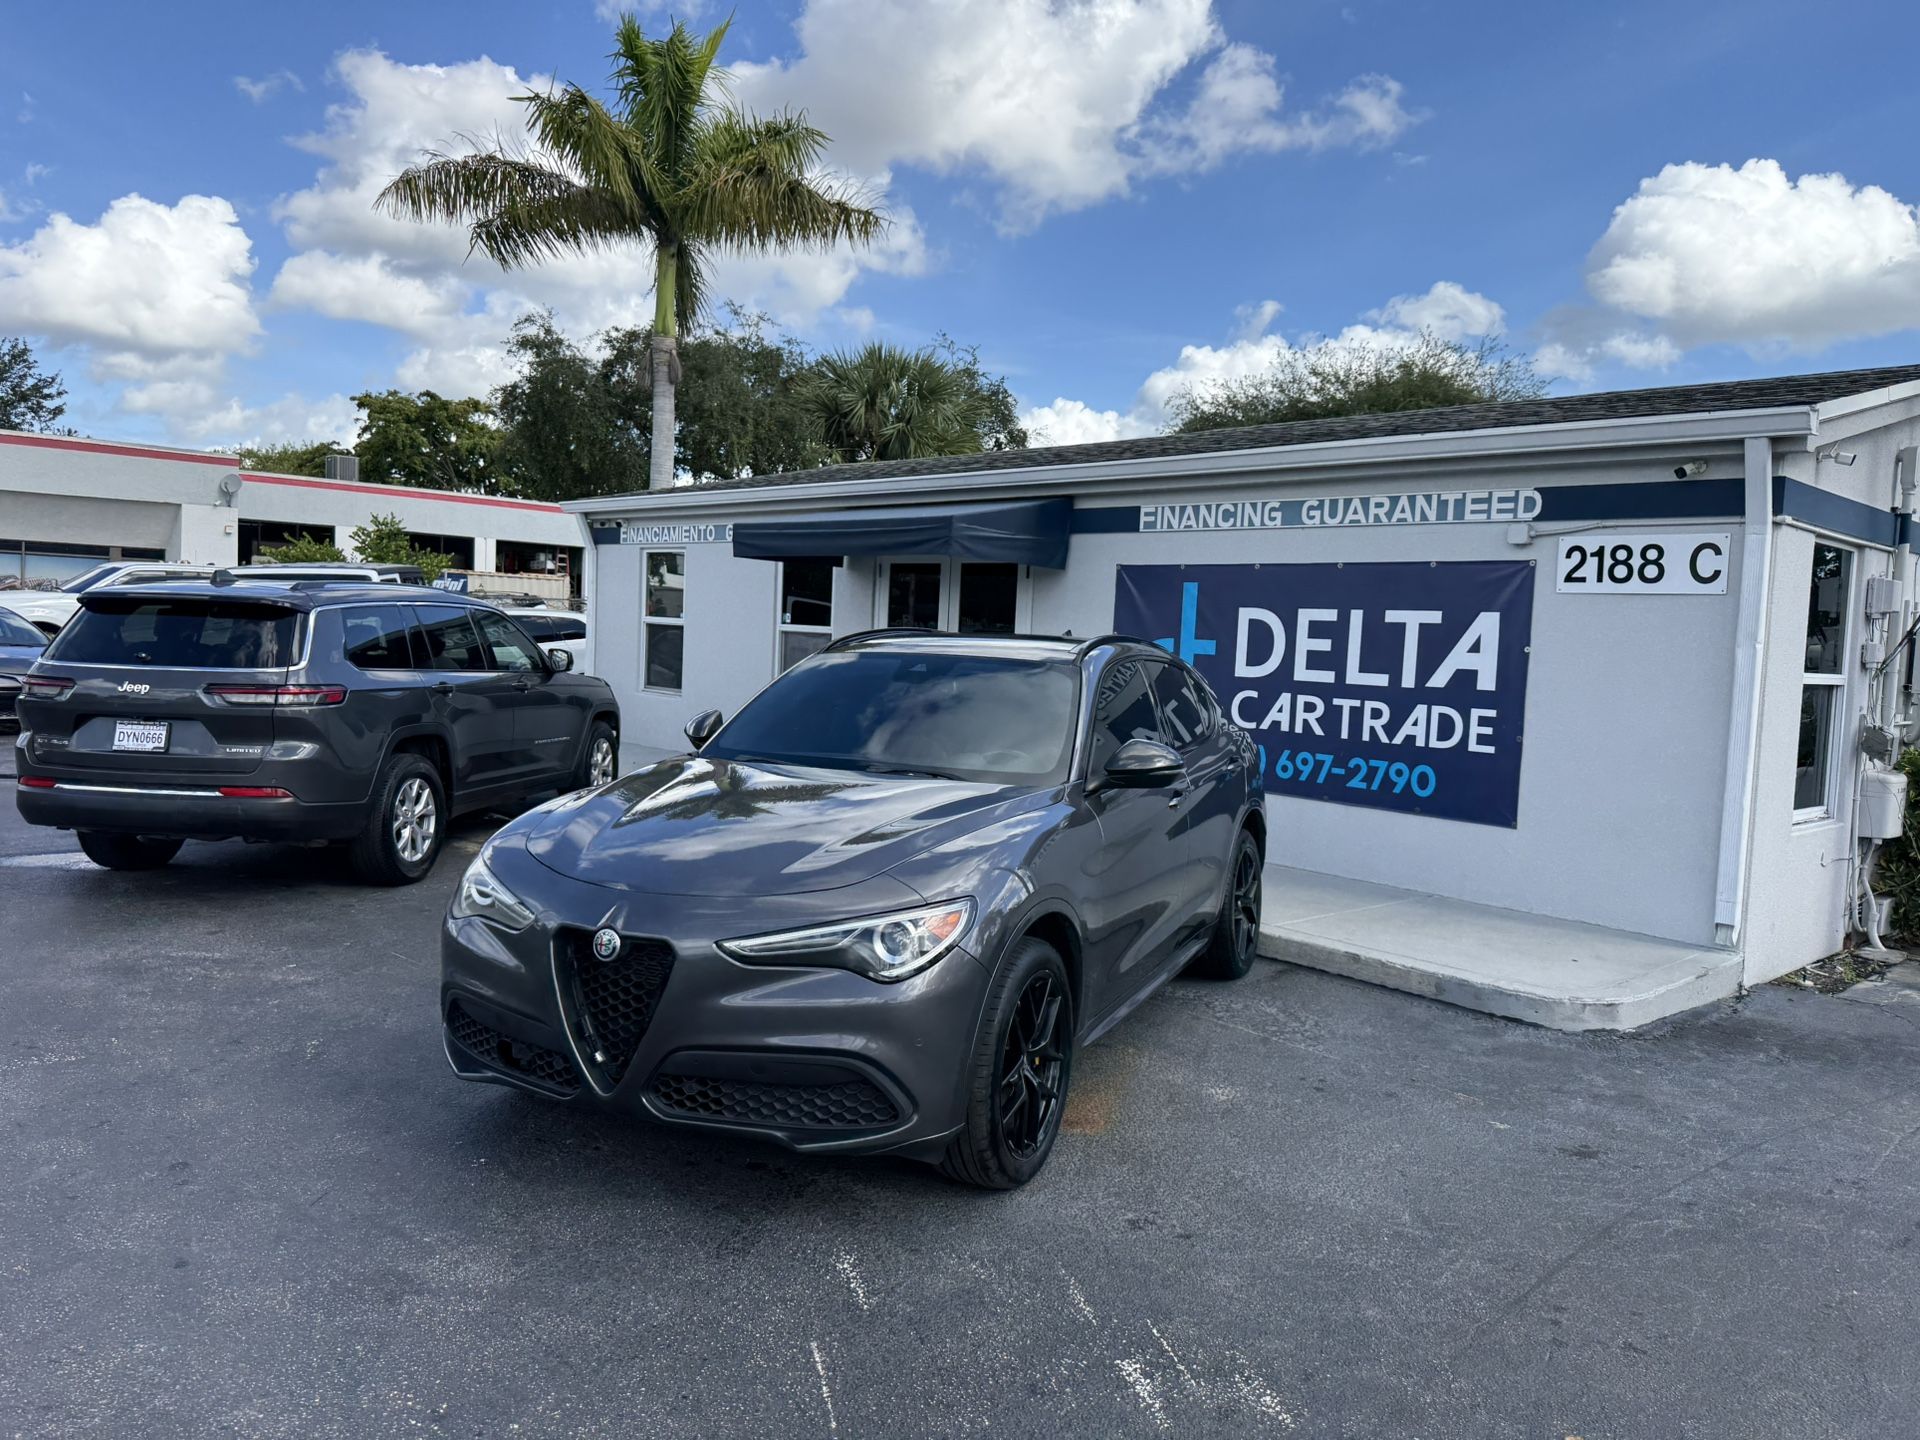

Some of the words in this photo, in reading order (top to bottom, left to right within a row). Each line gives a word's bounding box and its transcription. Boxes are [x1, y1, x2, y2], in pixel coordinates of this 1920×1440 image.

[1140, 502, 1282, 530] FINANCING
[1301, 490, 1543, 525] GUARANTEED
[621, 525, 715, 544] FINANCIAMIENTO
[1563, 544, 1665, 584] 2188
[1689, 542, 1723, 584] C
[1234, 607, 1500, 691] DELTA
[118, 680, 150, 695] Jeep
[117, 731, 163, 744] DYN0666
[1275, 749, 1436, 798] 697-2790
